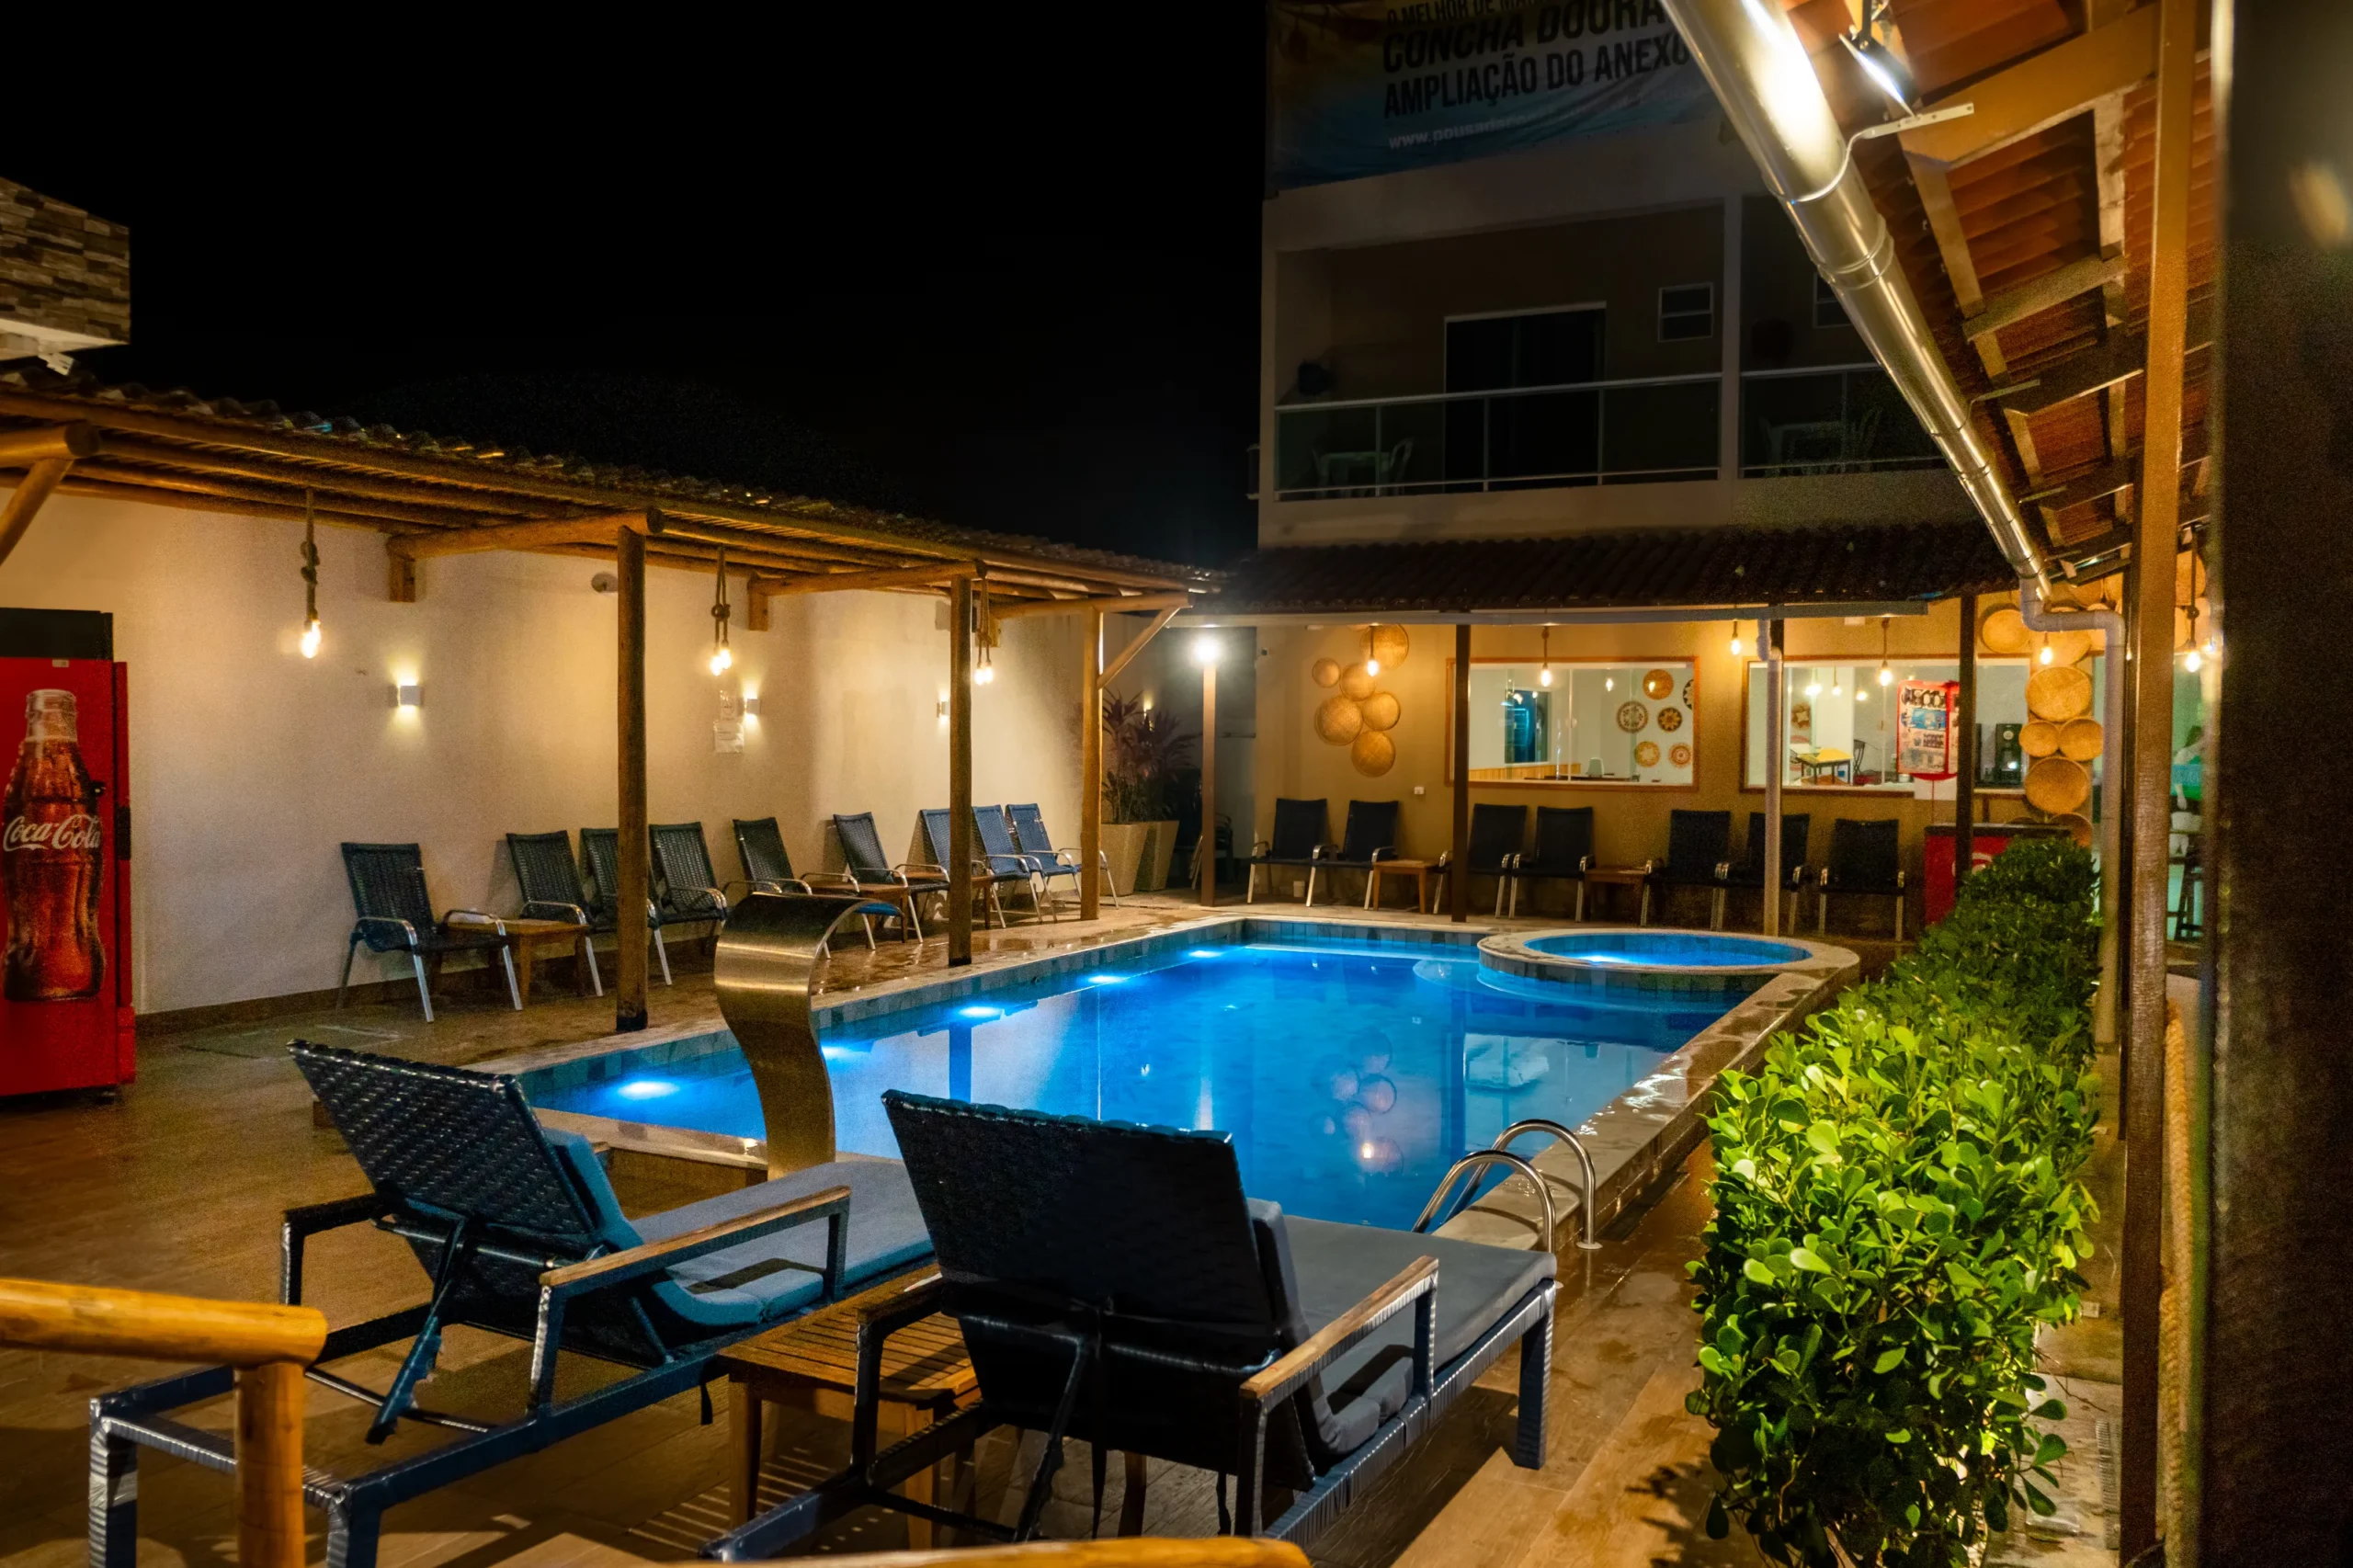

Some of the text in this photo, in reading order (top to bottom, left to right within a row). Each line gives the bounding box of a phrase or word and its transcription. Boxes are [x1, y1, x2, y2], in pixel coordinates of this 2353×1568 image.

[1382, 0, 1677, 73] CONCHA DOURA
[1386, 9, 1398, 27] O
[1402, 0, 1470, 26] MELHOR
[1473, 0, 1496, 15] DE
[1384, 27, 1689, 119] AMPLIAÇÃO DO ANEXO
[3, 813, 101, 852] Coca-Cola
